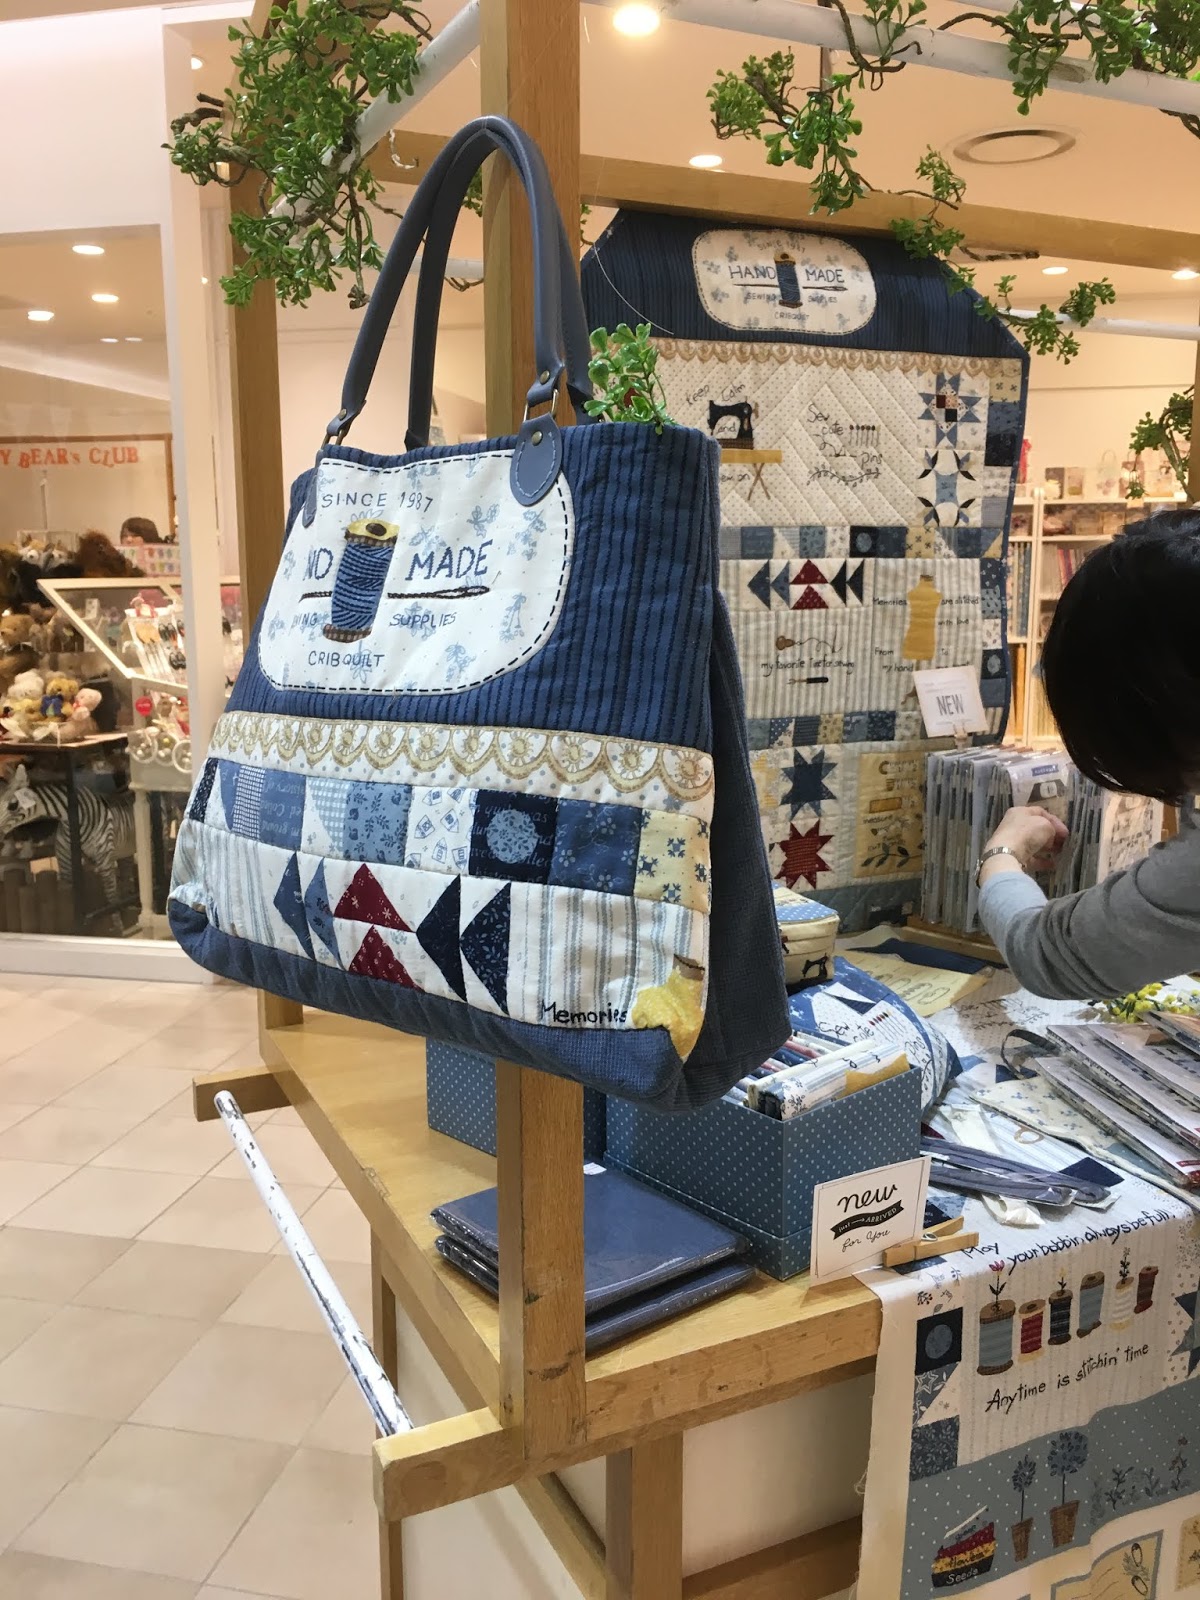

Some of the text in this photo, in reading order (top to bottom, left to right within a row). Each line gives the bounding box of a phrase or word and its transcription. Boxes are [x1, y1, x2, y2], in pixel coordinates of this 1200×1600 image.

[728, 265, 845, 283] HAND MADE
[807, 403, 830, 423] Sew
[88, 446, 139, 468] CLUB
[321, 492, 434, 513] SINCE 1987
[404, 539, 493, 582] MADE
[389, 613, 456, 629] SUPPLIES
[936, 694, 964, 716] NEW
[541, 999, 628, 1024] Memories
[837, 1184, 898, 1213] new
[838, 1207, 897, 1233] just ARRIVED
[842, 1237, 862, 1252] for
[961, 1242, 999, 1259] May
[1007, 1248, 1039, 1276] your
[1037, 1234, 1084, 1257] bobbin
[1084, 1226, 1131, 1245] always
[1128, 1217, 1148, 1230] be
[985, 1382, 1046, 1415] Anytime
[1057, 1374, 1070, 1389] is
[1124, 1343, 1149, 1362] time
[946, 1567, 979, 1585] Seeds
